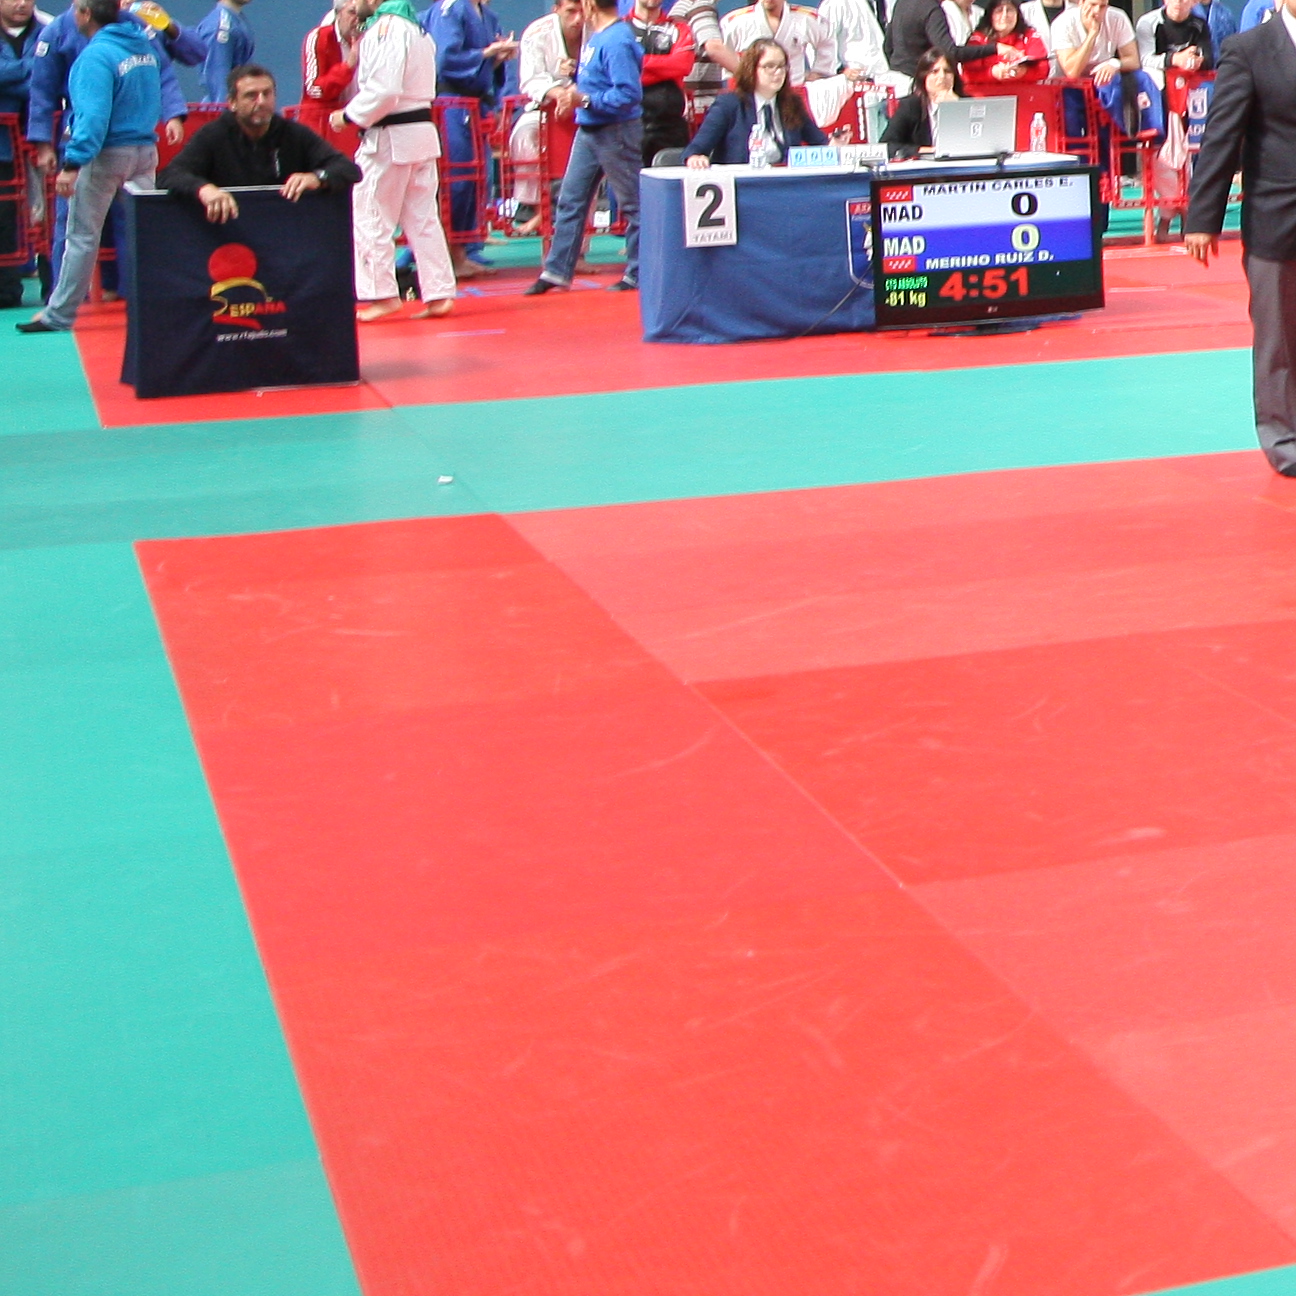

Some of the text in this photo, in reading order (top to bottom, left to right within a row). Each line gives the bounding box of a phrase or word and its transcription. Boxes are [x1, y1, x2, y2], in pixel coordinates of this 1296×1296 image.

[992, 178, 1054, 192] CARLES
[695, 184, 726, 229] 2
[883, 205, 923, 223] MAD
[1011, 192, 1039, 217] 0
[692, 230, 733, 244] TATAMI
[883, 223, 1041, 256] MAD 0
[925, 255, 990, 270] MERINO
[995, 251, 1034, 264] RUIZ
[938, 266, 1030, 301] 4:51
[909, 290, 927, 307] kg
